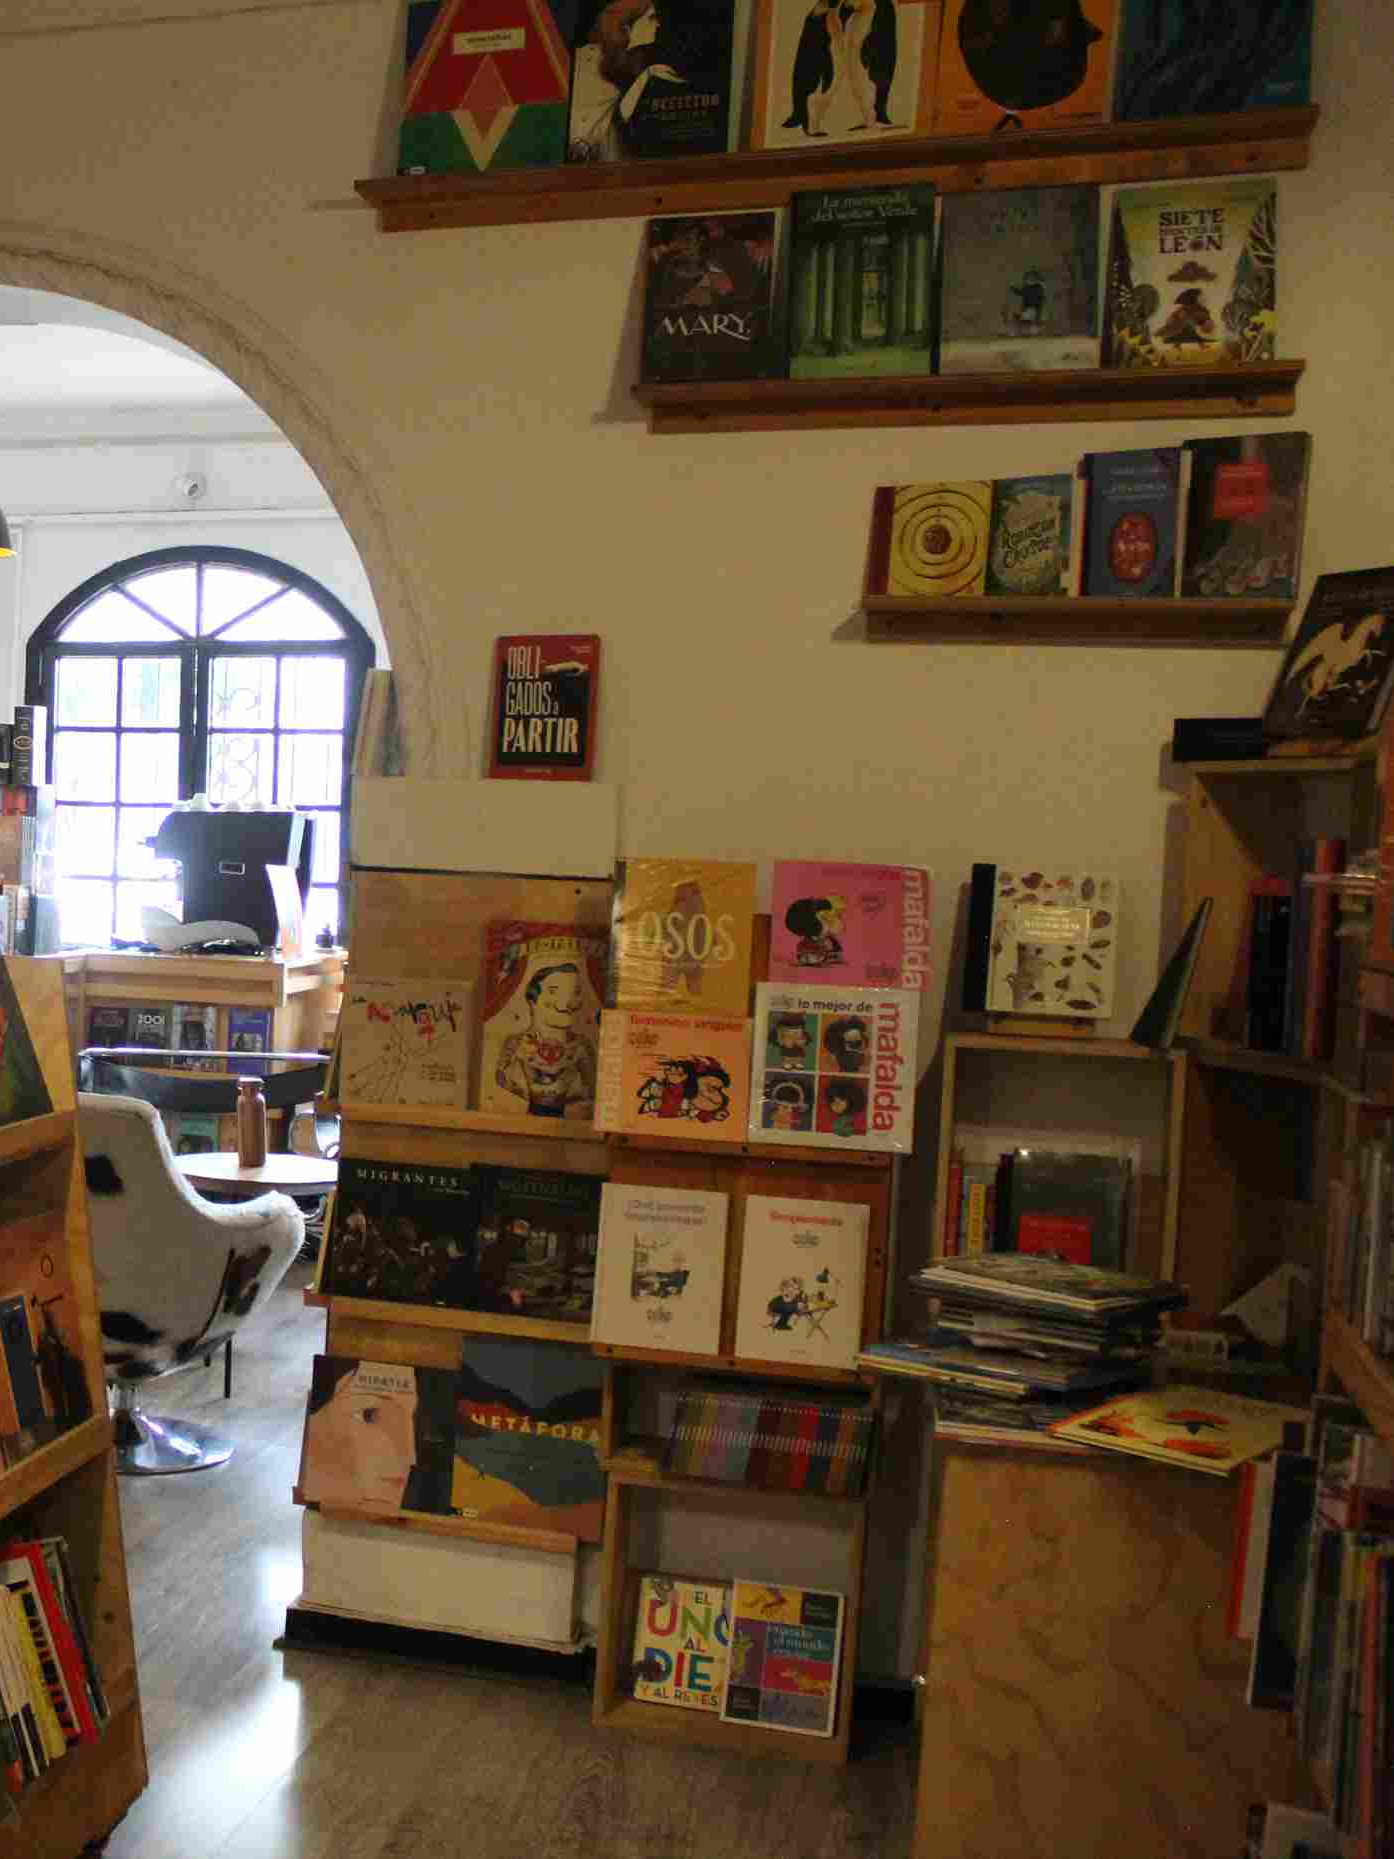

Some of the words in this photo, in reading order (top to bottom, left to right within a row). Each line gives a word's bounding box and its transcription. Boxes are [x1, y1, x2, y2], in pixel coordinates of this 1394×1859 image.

[506, 681, 552, 717] GADOS
[502, 718, 579, 753] PARTIR
[638, 912, 735, 961] OSOS
[902, 868, 931, 991] mafalda
[796, 998, 810, 1010] lo
[812, 999, 853, 1014] mejor
[855, 1001, 874, 1014] de
[871, 1003, 904, 1133] mafalda
[356, 1167, 461, 1188] MIGRANTES
[694, 1590, 712, 1606] EL
[684, 1633, 707, 1654] AL
